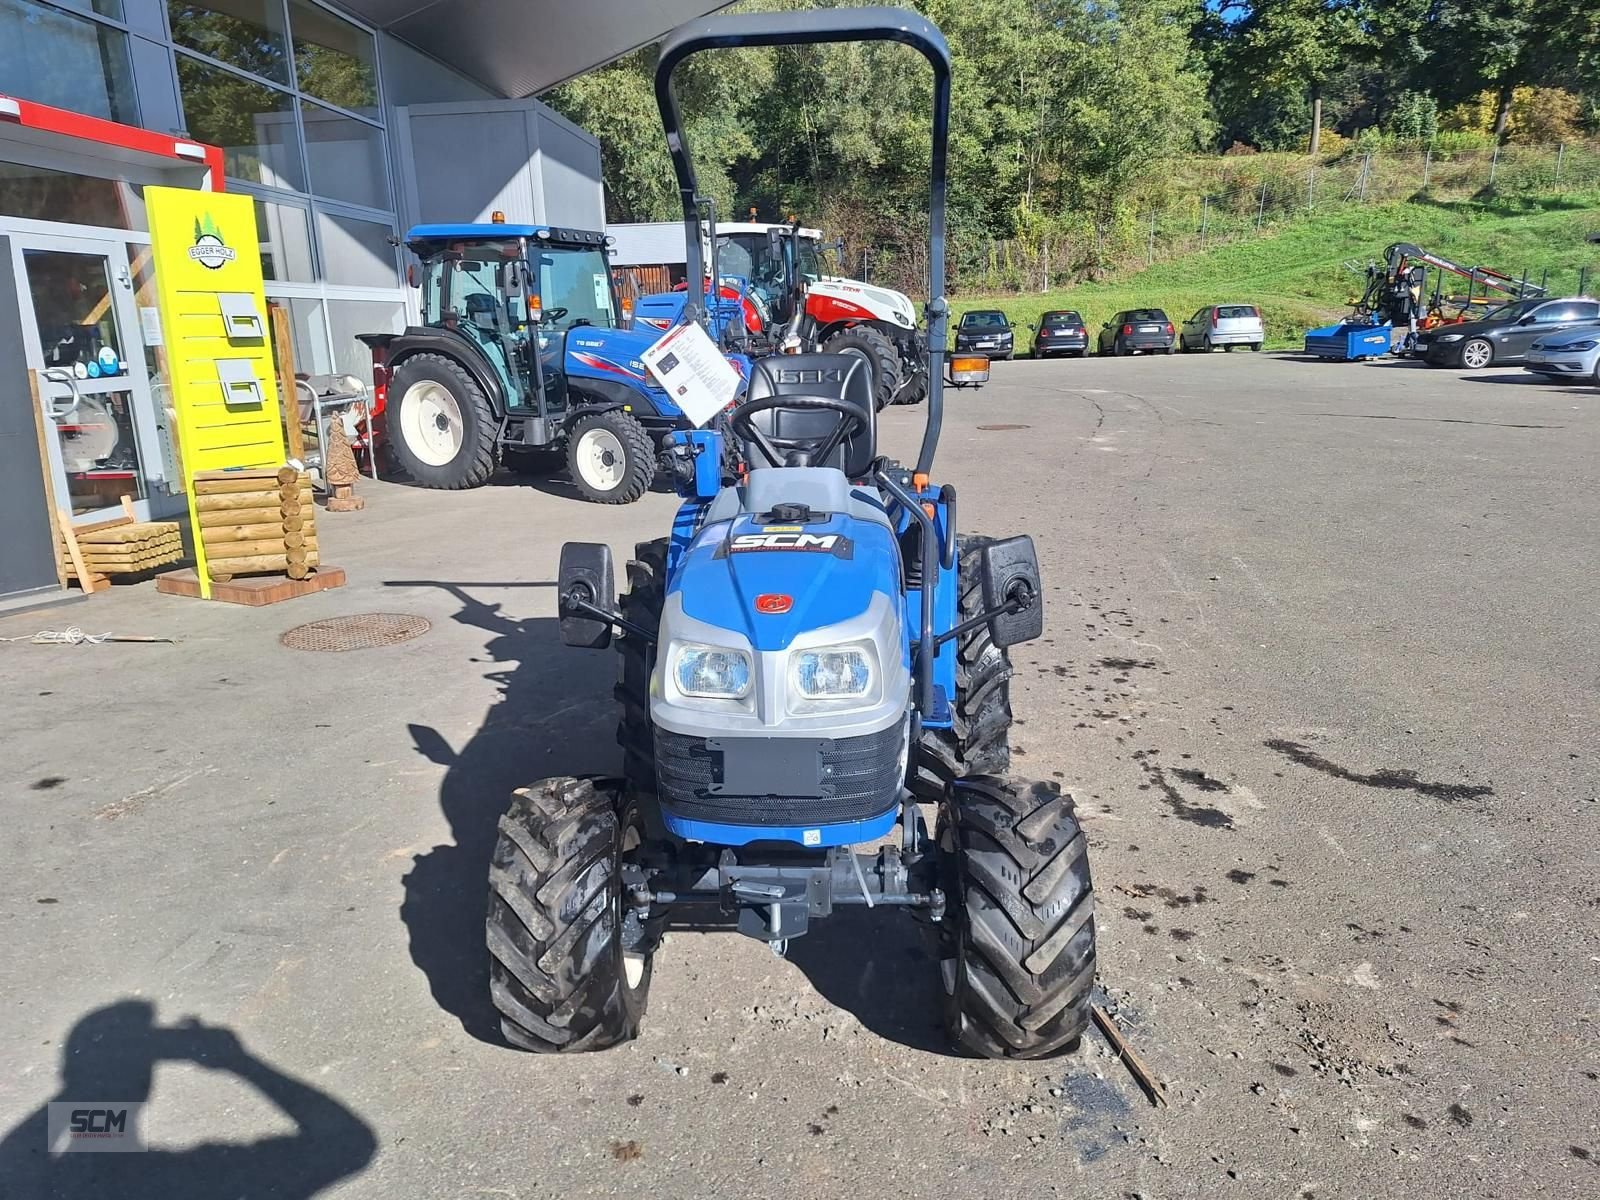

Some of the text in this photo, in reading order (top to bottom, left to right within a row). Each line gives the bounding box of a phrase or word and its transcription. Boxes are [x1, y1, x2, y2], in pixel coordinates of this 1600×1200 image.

[191, 247, 233, 257] EGGER HOLZ
[629, 359, 645, 370] ISE
[773, 369, 841, 385] ISEKI
[731, 534, 838, 549] SCM
